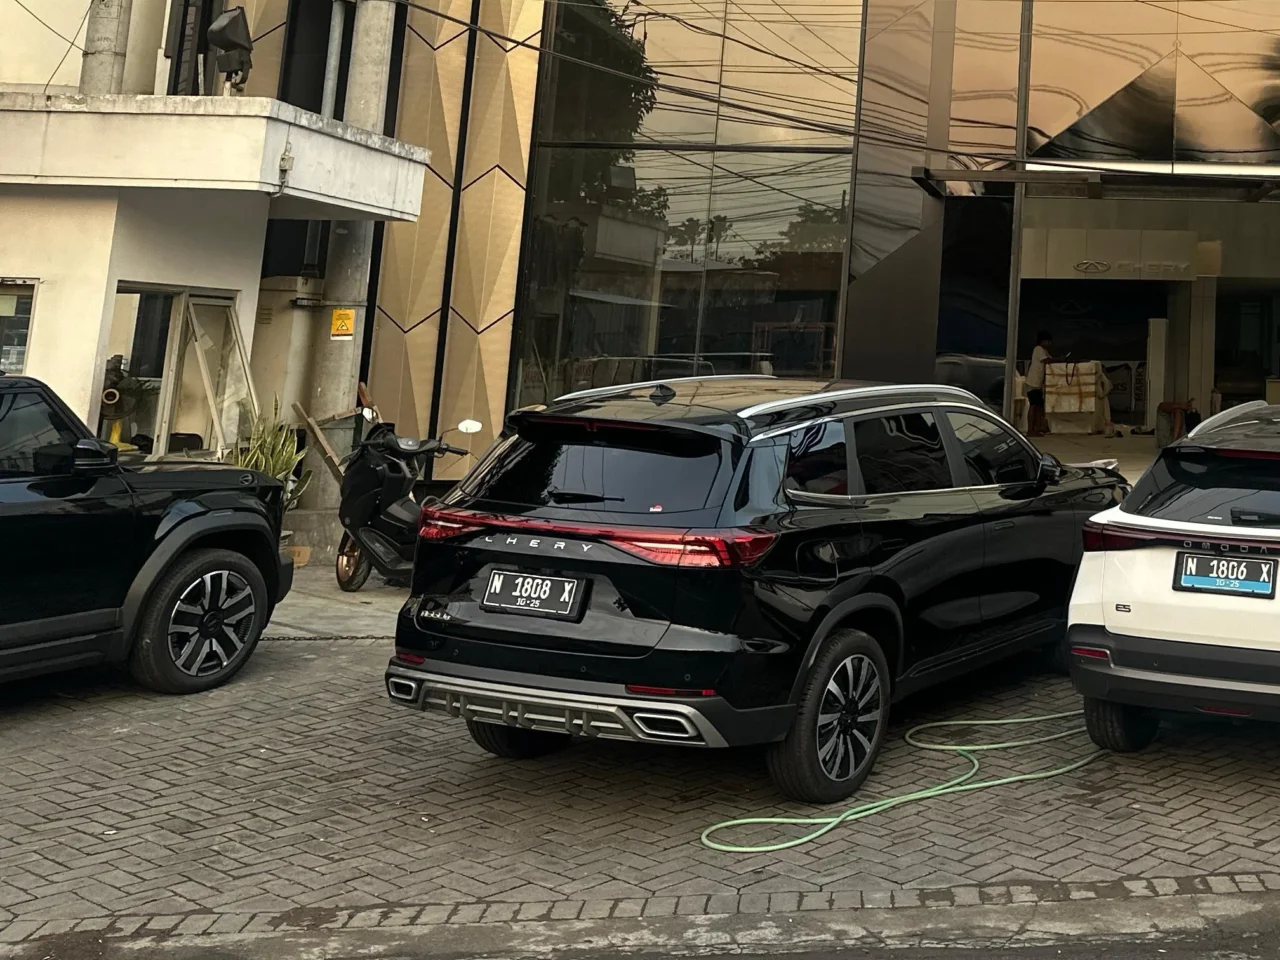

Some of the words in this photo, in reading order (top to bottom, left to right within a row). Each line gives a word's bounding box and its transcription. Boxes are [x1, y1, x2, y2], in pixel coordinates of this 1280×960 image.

[1115, 261, 1192, 273] CHERY
[485, 537, 592, 552] CHERY
[1186, 557, 1197, 575] N
[1209, 560, 1248, 580] 1806
[1259, 563, 1271, 582] X
[490, 574, 504, 594] N
[511, 577, 552, 599] 1808
[560, 582, 573, 602] X
